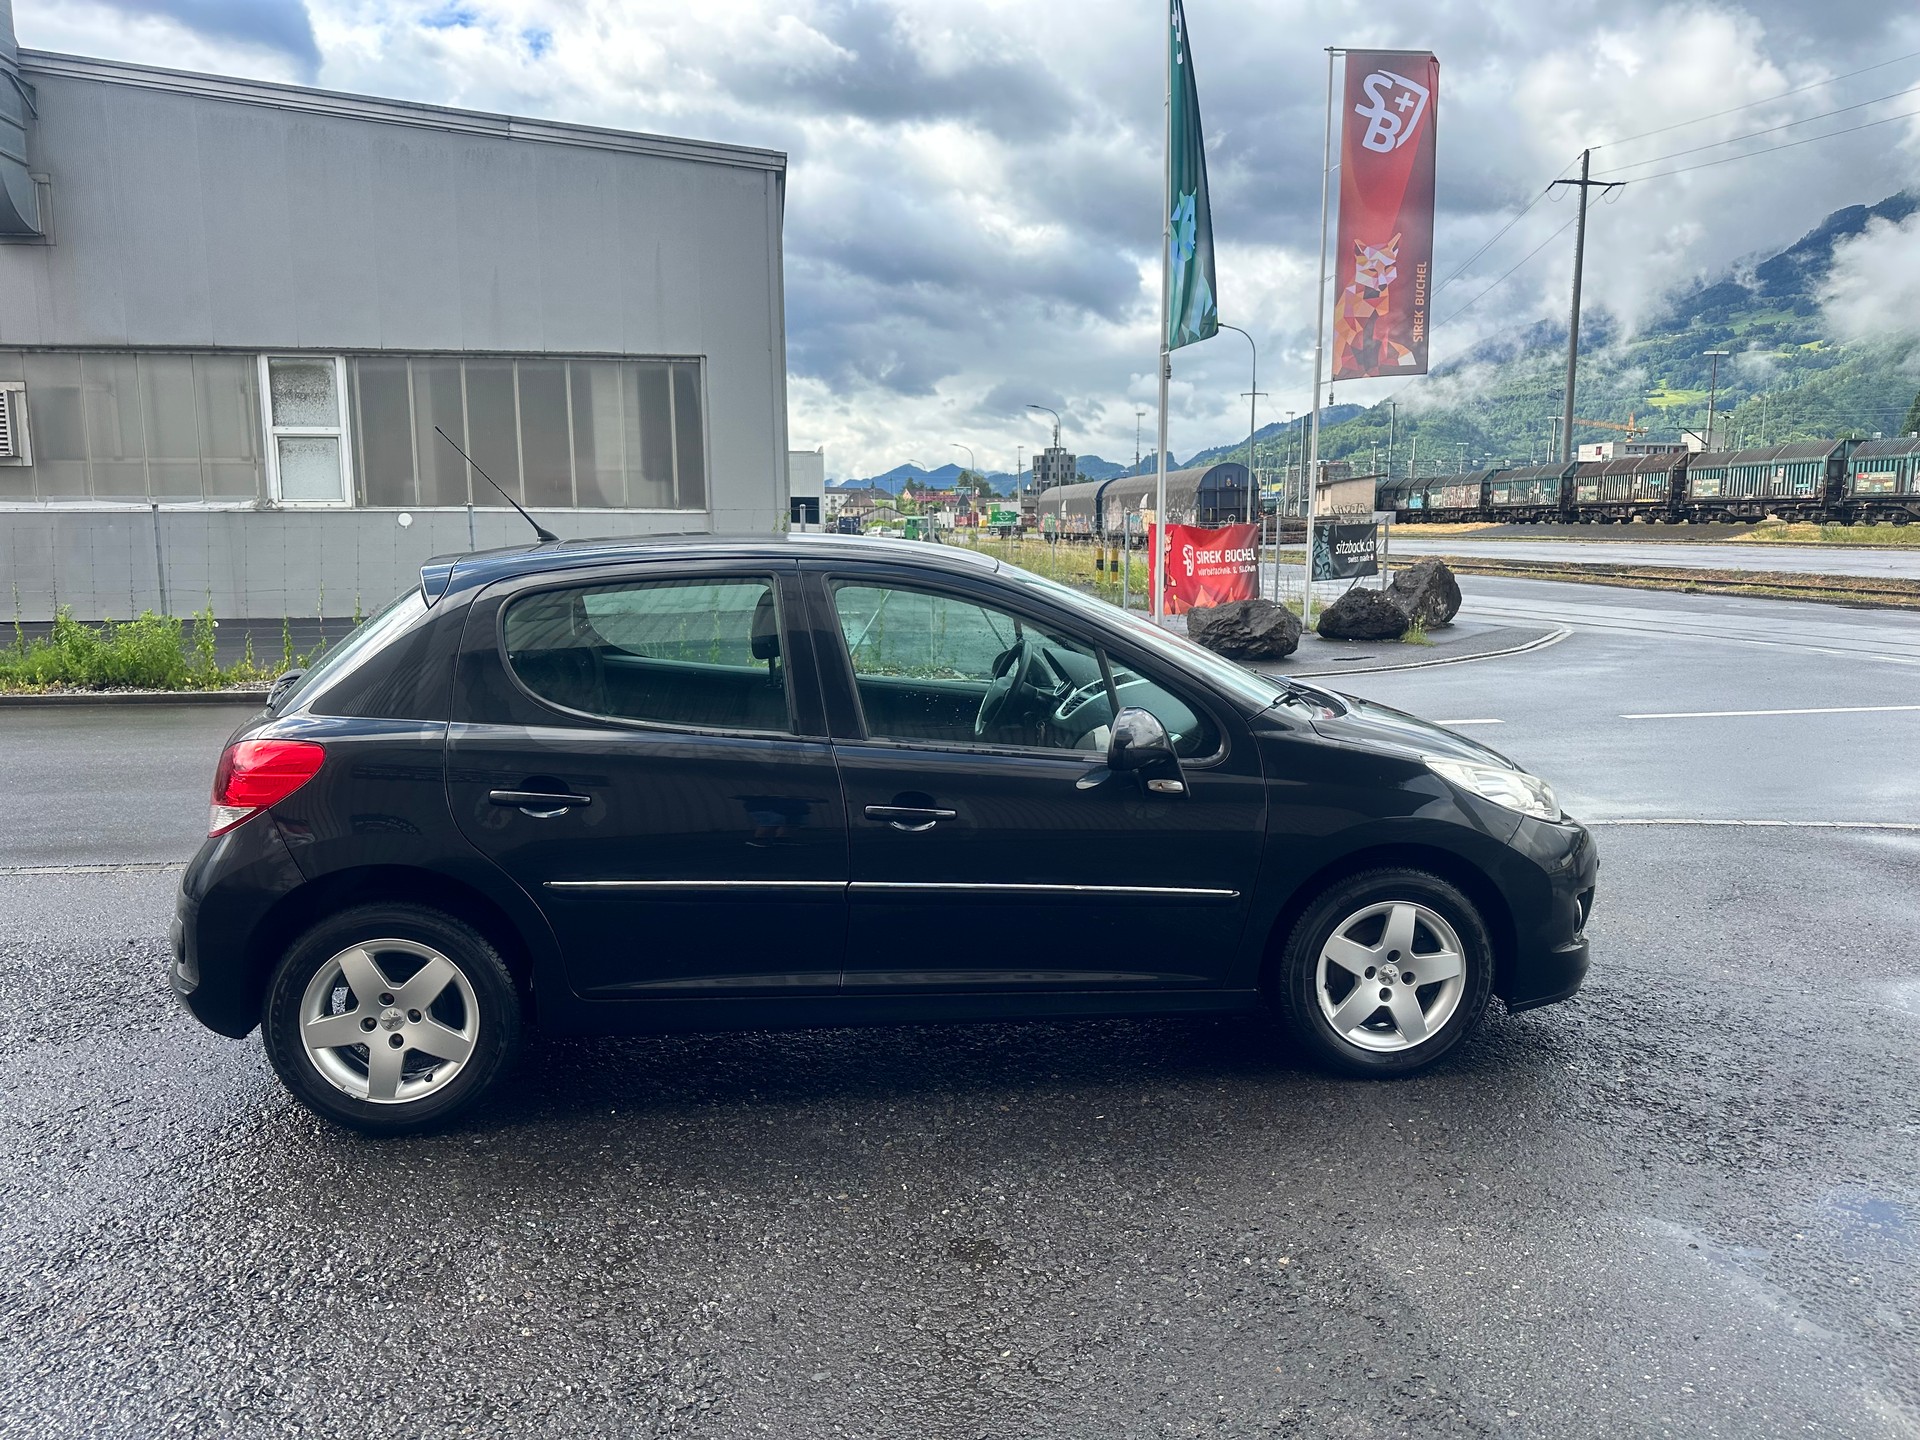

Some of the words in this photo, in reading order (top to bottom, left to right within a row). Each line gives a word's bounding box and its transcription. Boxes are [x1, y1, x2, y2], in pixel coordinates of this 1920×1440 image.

[1412, 310, 1424, 343] SIREK
[1336, 538, 1375, 554] sitzbock.ch
[1196, 551, 1222, 564] SIREK
